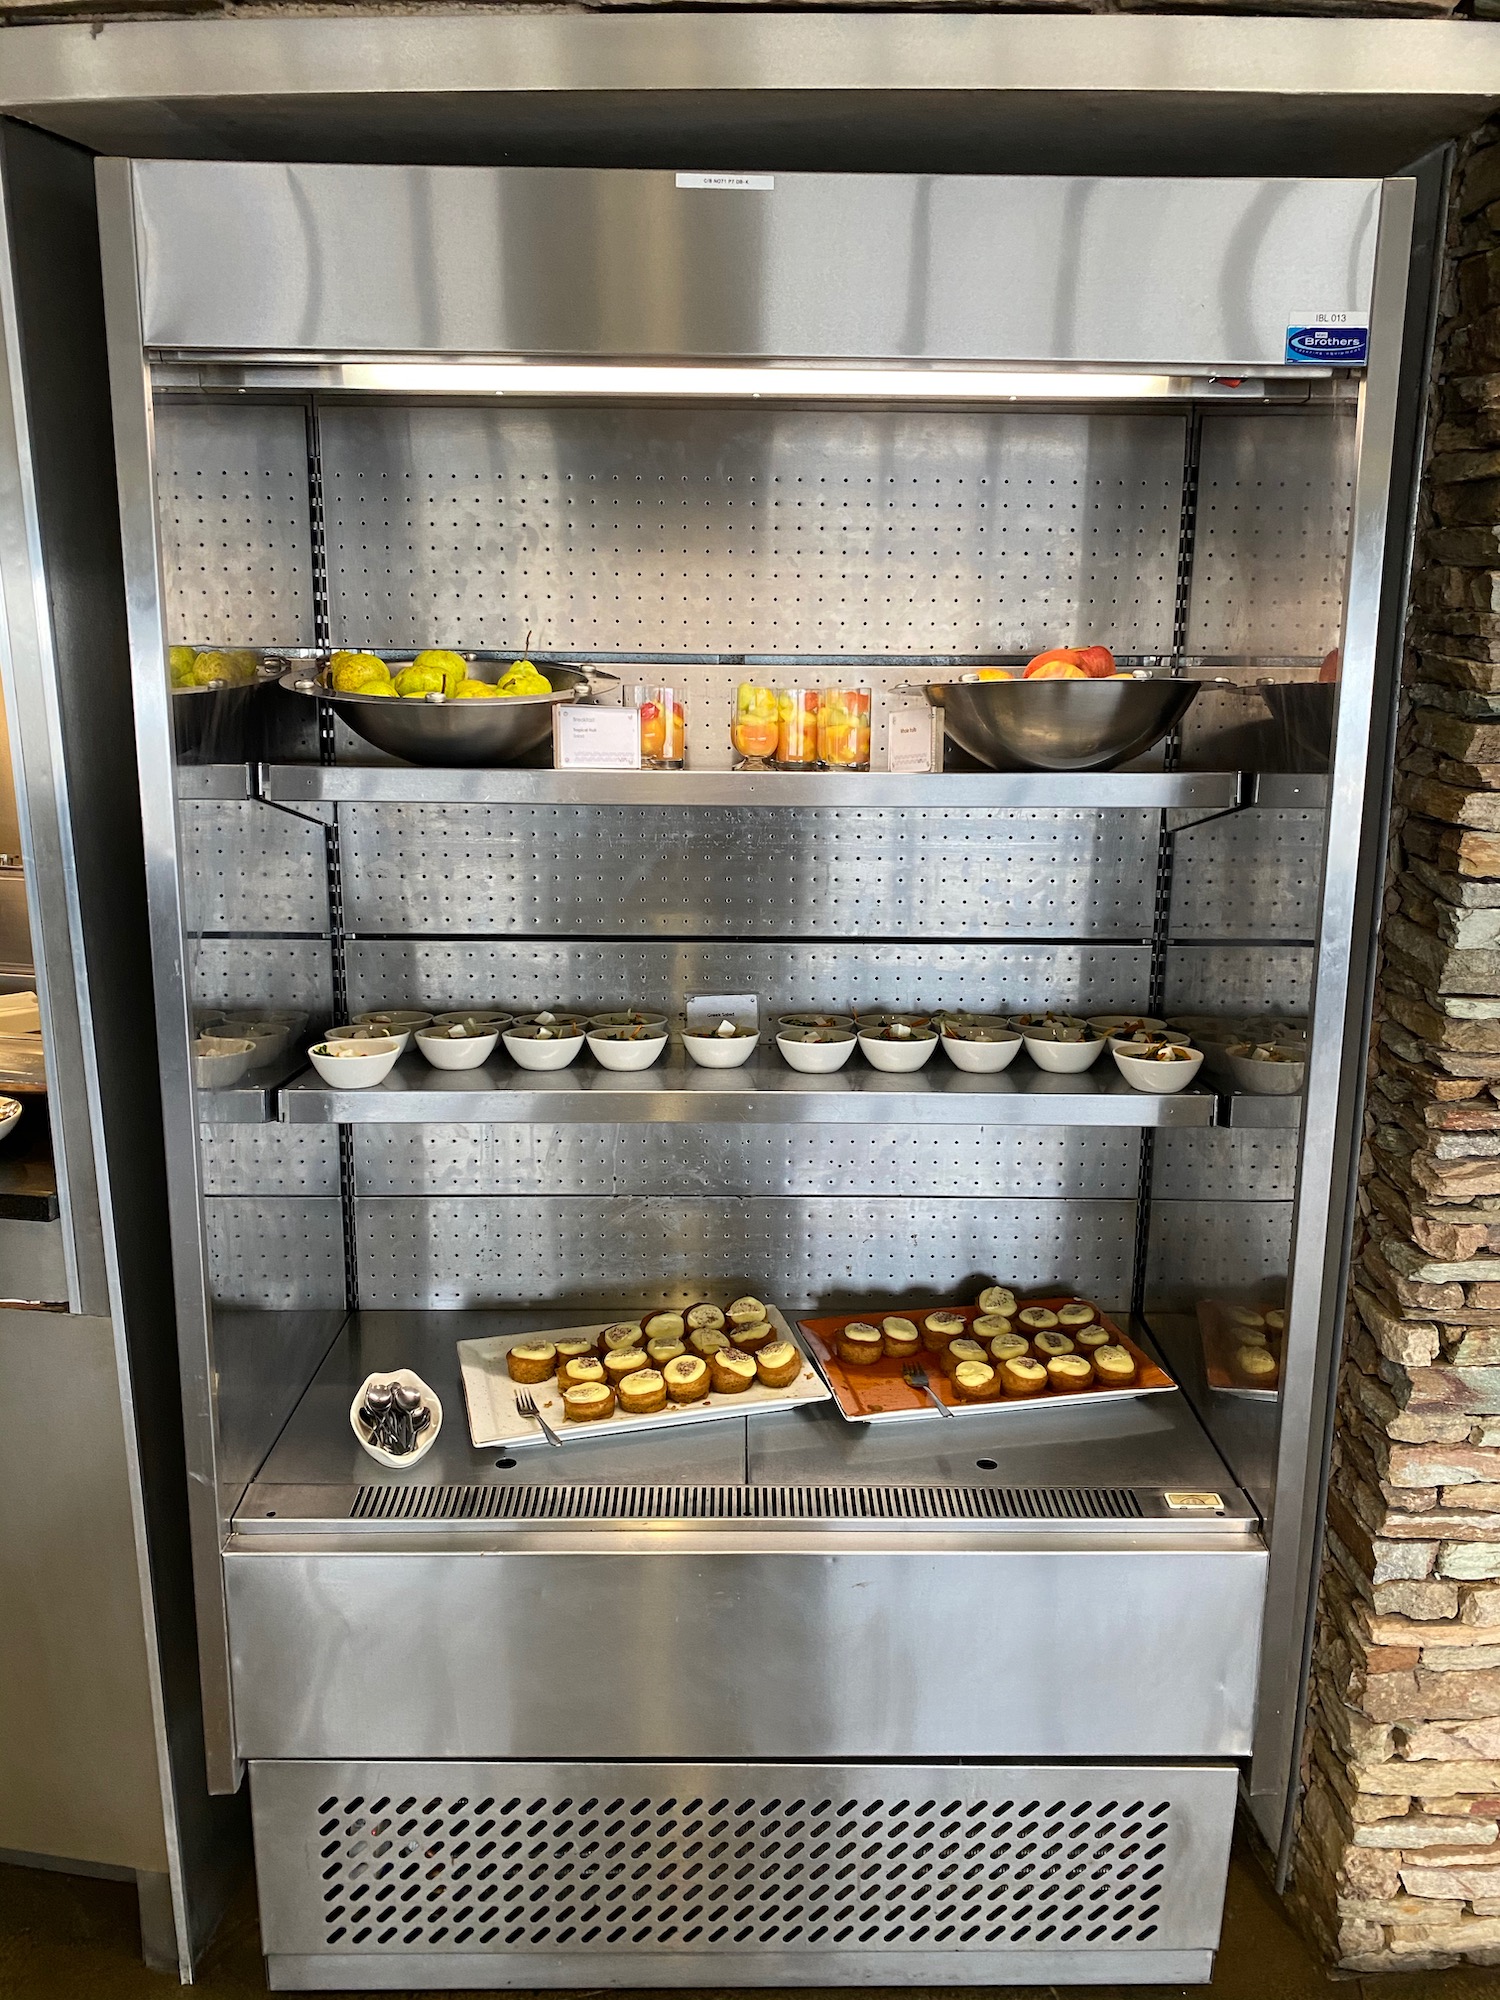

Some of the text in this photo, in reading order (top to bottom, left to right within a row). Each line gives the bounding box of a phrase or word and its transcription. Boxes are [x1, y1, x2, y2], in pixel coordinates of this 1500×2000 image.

[1315, 313, 1347, 322] IBL 013
[1304, 337, 1360, 346] Brothers
